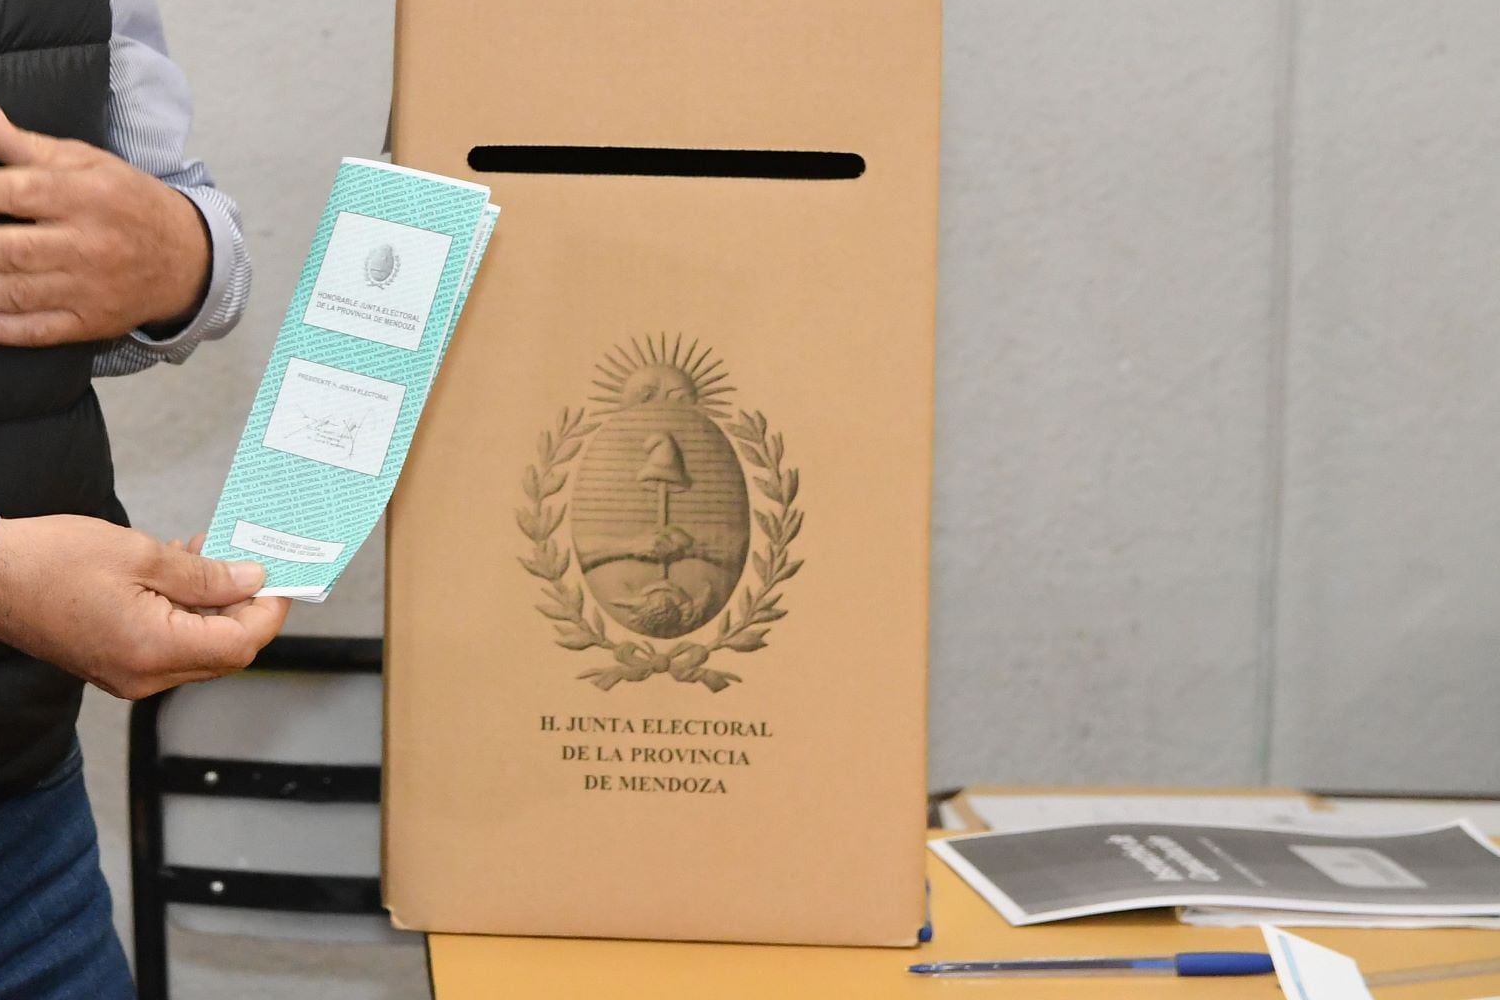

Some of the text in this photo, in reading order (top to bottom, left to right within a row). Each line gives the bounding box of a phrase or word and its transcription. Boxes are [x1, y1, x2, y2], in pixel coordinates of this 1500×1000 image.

[316, 301, 416, 332] DE LA PROVINCIA DE MENDOZA
[317, 292, 421, 323] HONORABLE JUNTA ELECTORAL
[297, 372, 332, 385] PRESIDENTE
[338, 383, 356, 393] JUNTA
[357, 388, 389, 402] ELECTORAL
[540, 716, 773, 737] H. JUNTA ELECTORAL
[562, 745, 750, 766] DE LA PROVINCIA
[584, 774, 727, 794] DE MENDOZA
